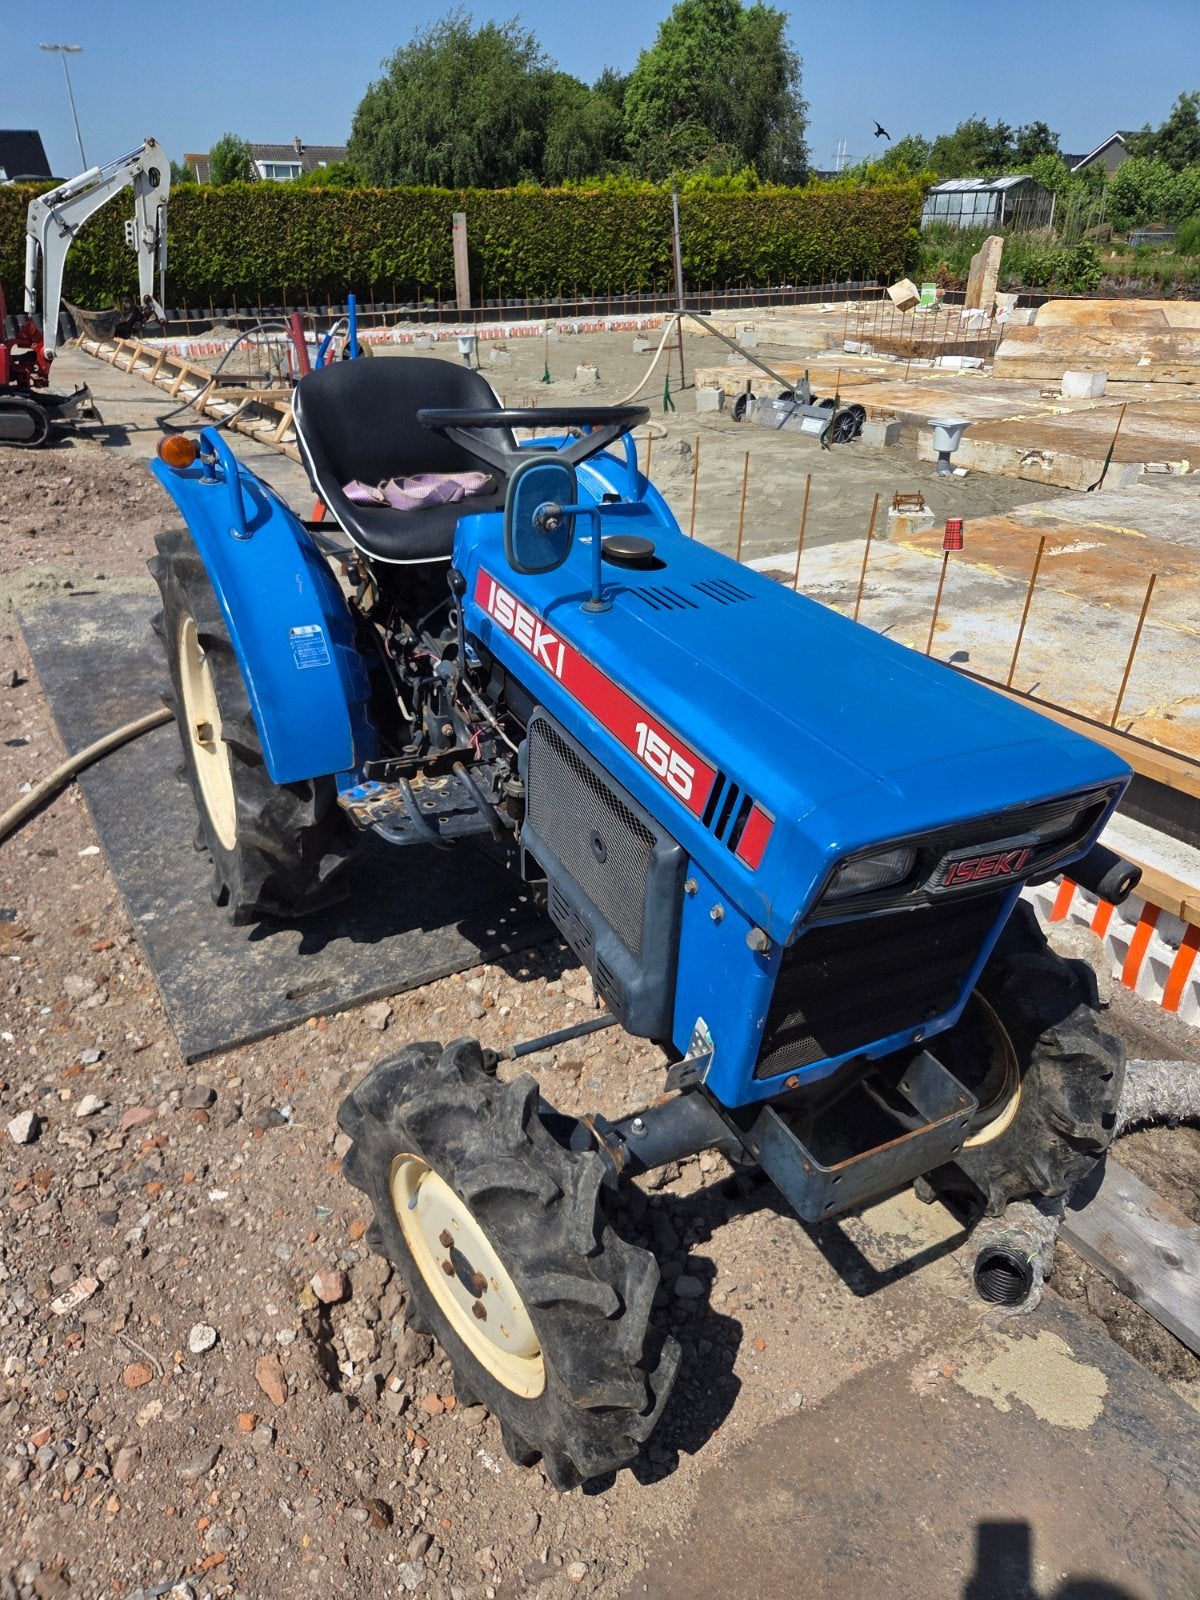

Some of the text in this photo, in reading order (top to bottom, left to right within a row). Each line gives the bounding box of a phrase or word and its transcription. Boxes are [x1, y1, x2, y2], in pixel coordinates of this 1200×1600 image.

[487, 580, 565, 679] ISEKI
[635, 722, 695, 800] 155
[943, 849, 1030, 887] ISEKI
